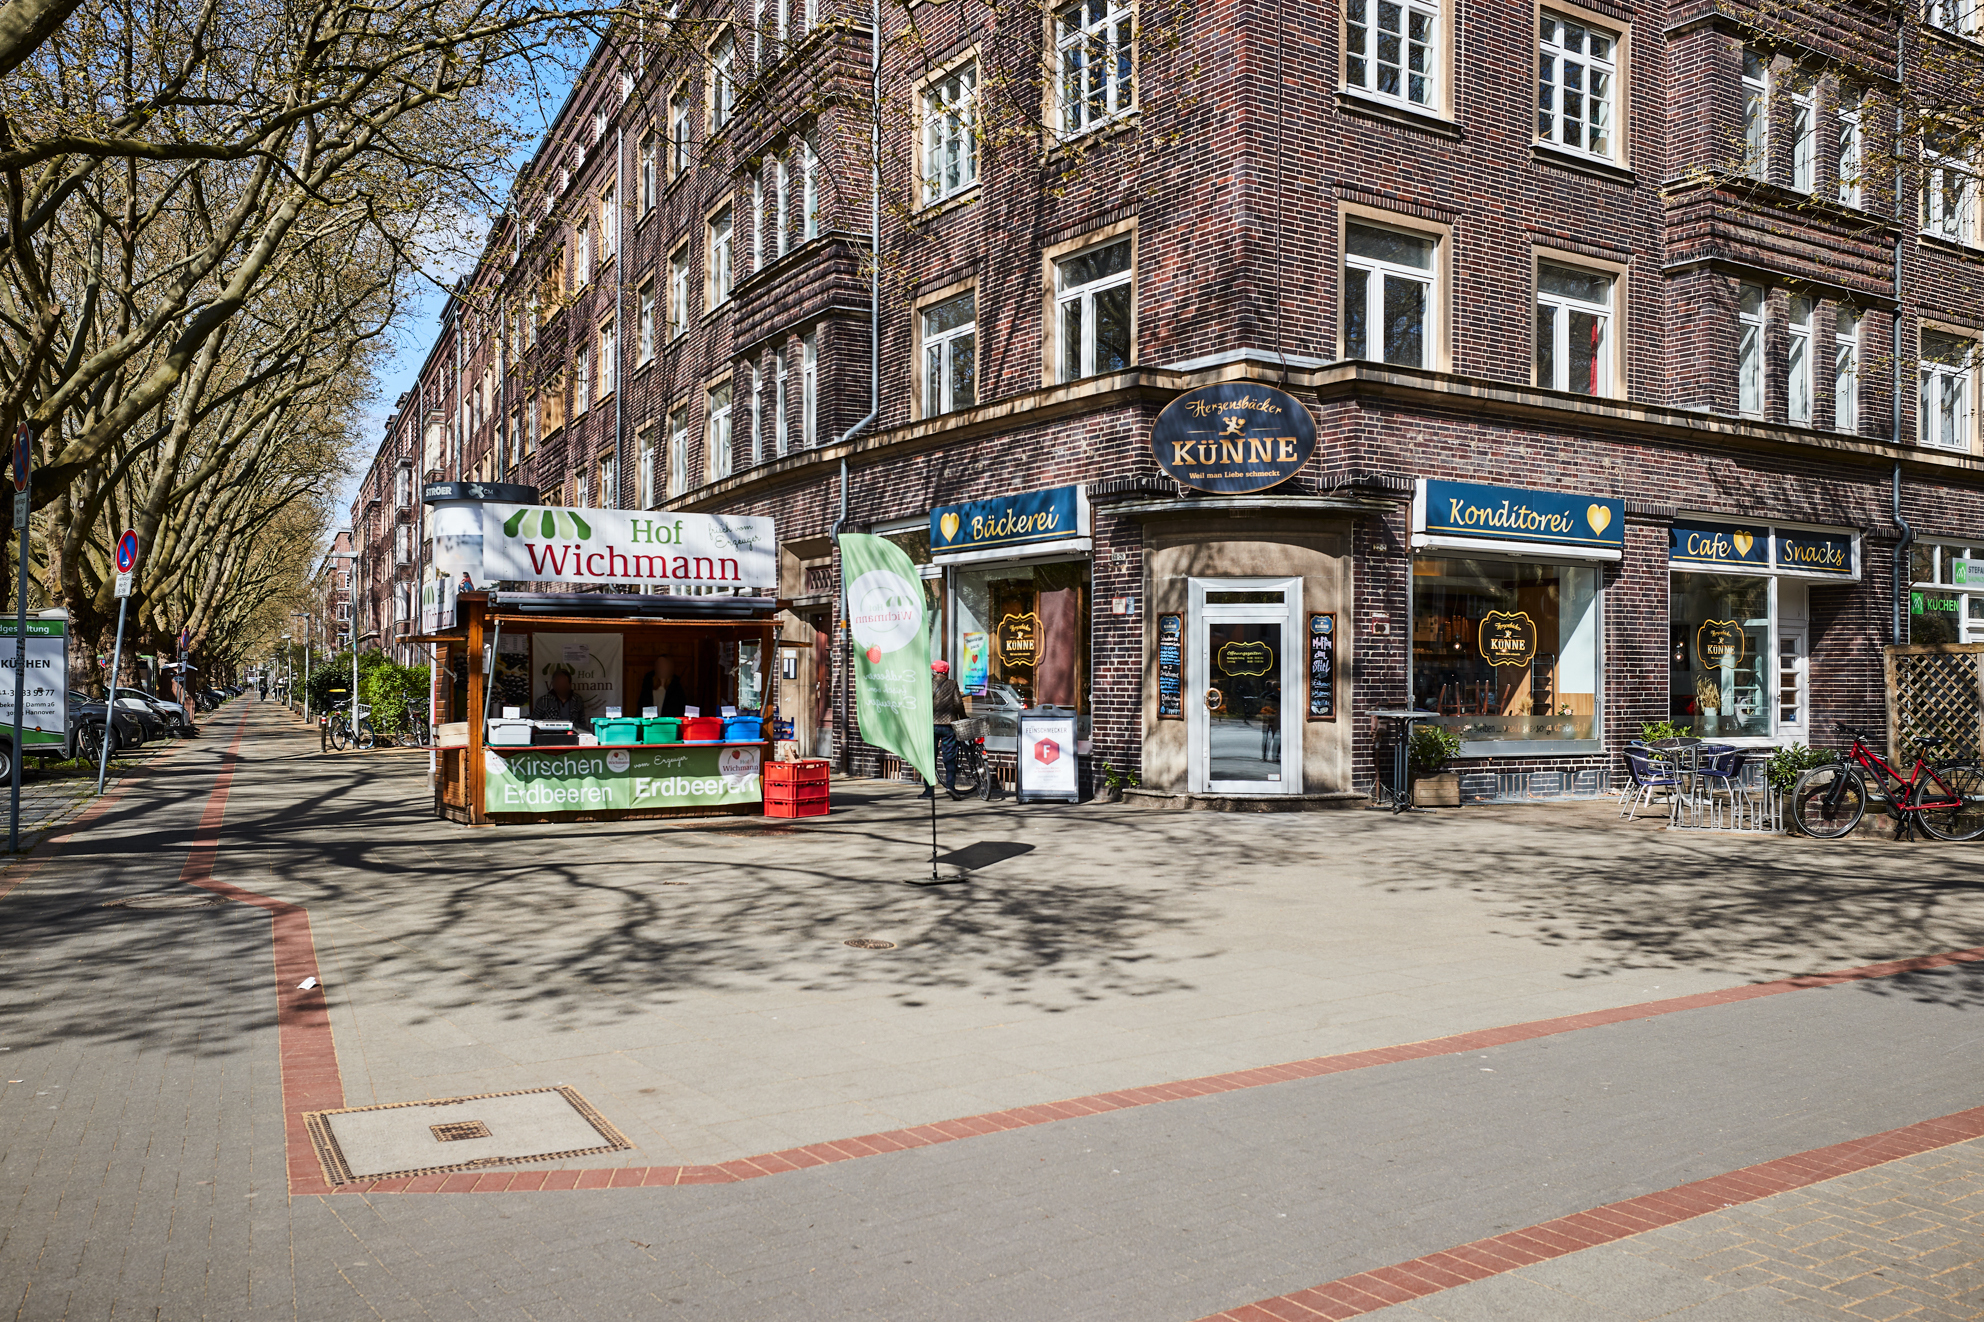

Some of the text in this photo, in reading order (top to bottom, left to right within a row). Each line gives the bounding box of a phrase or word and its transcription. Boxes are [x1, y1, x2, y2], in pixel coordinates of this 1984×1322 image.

[1184, 395, 1283, 418] Herzensbäcker
[1171, 437, 1298, 466] KÜNNE
[1189, 472, 1205, 480] Weil
[1224, 470, 1244, 479] Liebe
[1245, 470, 1281, 478] schmeckt
[425, 486, 453, 497] STRÖER
[971, 505, 1060, 540] Bäckerei
[1449, 498, 1574, 533] Konditorei
[631, 519, 684, 545] Hof
[708, 521, 733, 541] frisch
[715, 534, 761, 552] Erzeuger
[1687, 532, 1732, 562] Cafe
[1784, 539, 1846, 566] Snacks
[525, 543, 742, 581] Wichmann
[1927, 596, 1960, 612] KÜCHEN
[1006, 640, 1035, 651] KÜNNE
[1490, 638, 1526, 650] KÜNNE
[1707, 644, 1735, 655] KÜNNE
[1, 657, 51, 669] KÜHEN
[577, 670, 595, 679] Hof
[45, 689, 55, 697] 77
[1025, 726, 1068, 734] FEINSCHMECKER
[1043, 744, 1051, 759] F
[510, 756, 603, 776] Kirschen
[633, 755, 689, 769] vom Erzeuger
[722, 764, 759, 773] Wichmann
[504, 783, 613, 804] Erdbeeren
[635, 776, 755, 798] Erdbeeren
